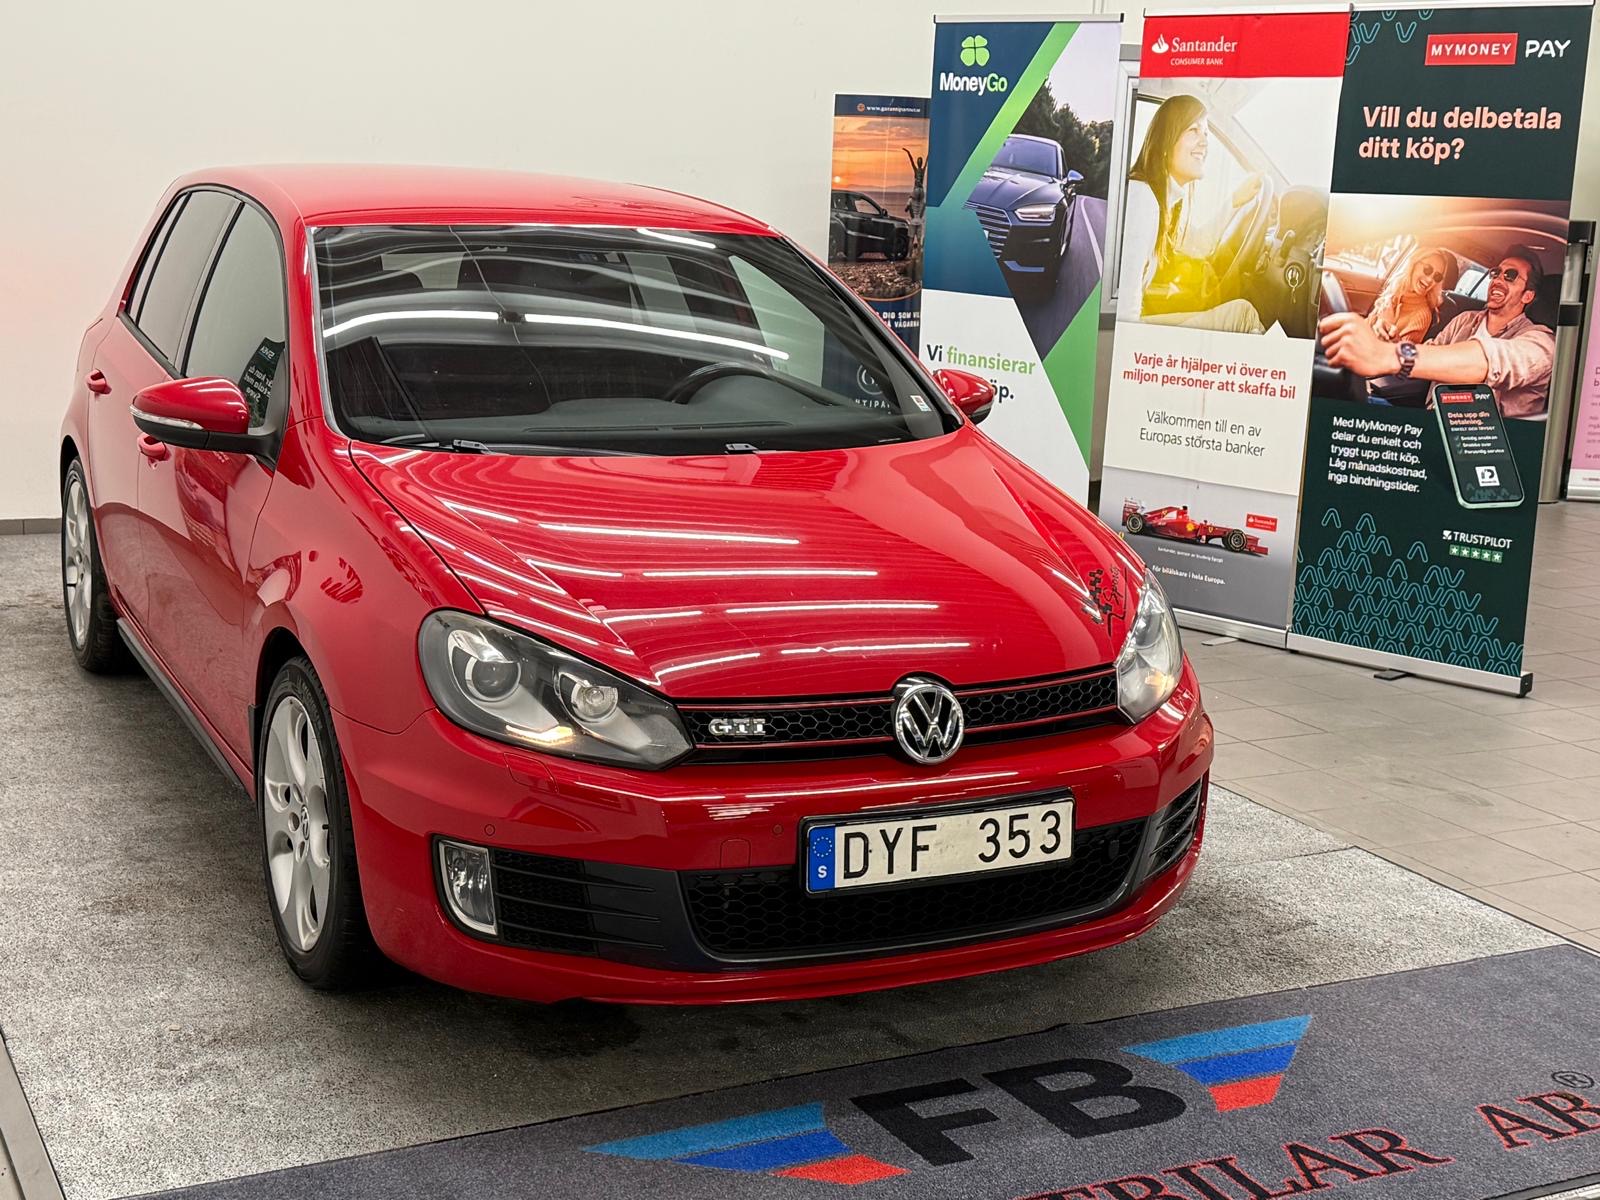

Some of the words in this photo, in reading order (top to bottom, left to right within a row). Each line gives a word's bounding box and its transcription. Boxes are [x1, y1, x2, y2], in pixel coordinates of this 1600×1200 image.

[1171, 35, 1238, 53] Santander
[1431, 43, 1511, 56] MYMONEY
[1525, 39, 1571, 58] PAY
[1170, 57, 1204, 66] CONSUMER
[1206, 57, 1223, 65] BANK
[939, 72, 1008, 96] MoneyGo
[1363, 105, 1400, 128] Vill
[1406, 106, 1437, 128] du
[1443, 106, 1562, 130] delbetala
[1358, 136, 1400, 158] ditt
[1405, 136, 1465, 165] köp?
[927, 343, 943, 362] Vi
[947, 345, 1036, 375] finansierar
[1134, 352, 1163, 368] Varje
[1166, 354, 1178, 368] år
[1181, 357, 1223, 375] hjälper
[1226, 364, 1236, 375] vi
[1240, 365, 1268, 378] över
[1270, 370, 1286, 380] en
[1123, 369, 1158, 385] miljon
[1161, 375, 1215, 391] personer
[1217, 380, 1235, 393] att
[1238, 381, 1276, 397] skaffa
[1280, 385, 1296, 400] bil
[1146, 410, 1211, 431] Välkommen
[1215, 419, 1228, 433] till
[1230, 424, 1244, 435] en
[1248, 425, 1262, 437] av
[1333, 416, 1354, 428] Med
[1355, 419, 1403, 435] MyMoney
[1404, 424, 1423, 437] Pay
[1139, 428, 1182, 445] Europas
[1185, 435, 1222, 452] största
[1225, 439, 1265, 457] banker
[1331, 430, 1356, 442] delar
[1357, 433, 1370, 444] du
[1371, 436, 1401, 448] enkelt
[1403, 439, 1422, 450] och
[1330, 444, 1359, 458] tryggt
[1361, 448, 1380, 460] upp
[1381, 450, 1398, 461] ditt
[1399, 452, 1421, 465] köp.
[1329, 457, 1347, 470] Låg
[1348, 461, 1427, 480] månadskostnad,
[1328, 470, 1348, 484] inga
[1349, 474, 1420, 493] bindningstider.
[1453, 531, 1513, 549] TRUSTPILOT
[1152, 564, 1161, 572] För
[1191, 572, 1203, 581] hela
[1204, 574, 1226, 585] Europa.
[708, 717, 767, 736] GTI
[817, 864, 828, 879] S
[843, 824, 938, 881] DYF
[978, 810, 1062, 863] 353
[852, 1057, 1187, 1168] FB
[1477, 1091, 1600, 1150] AB
